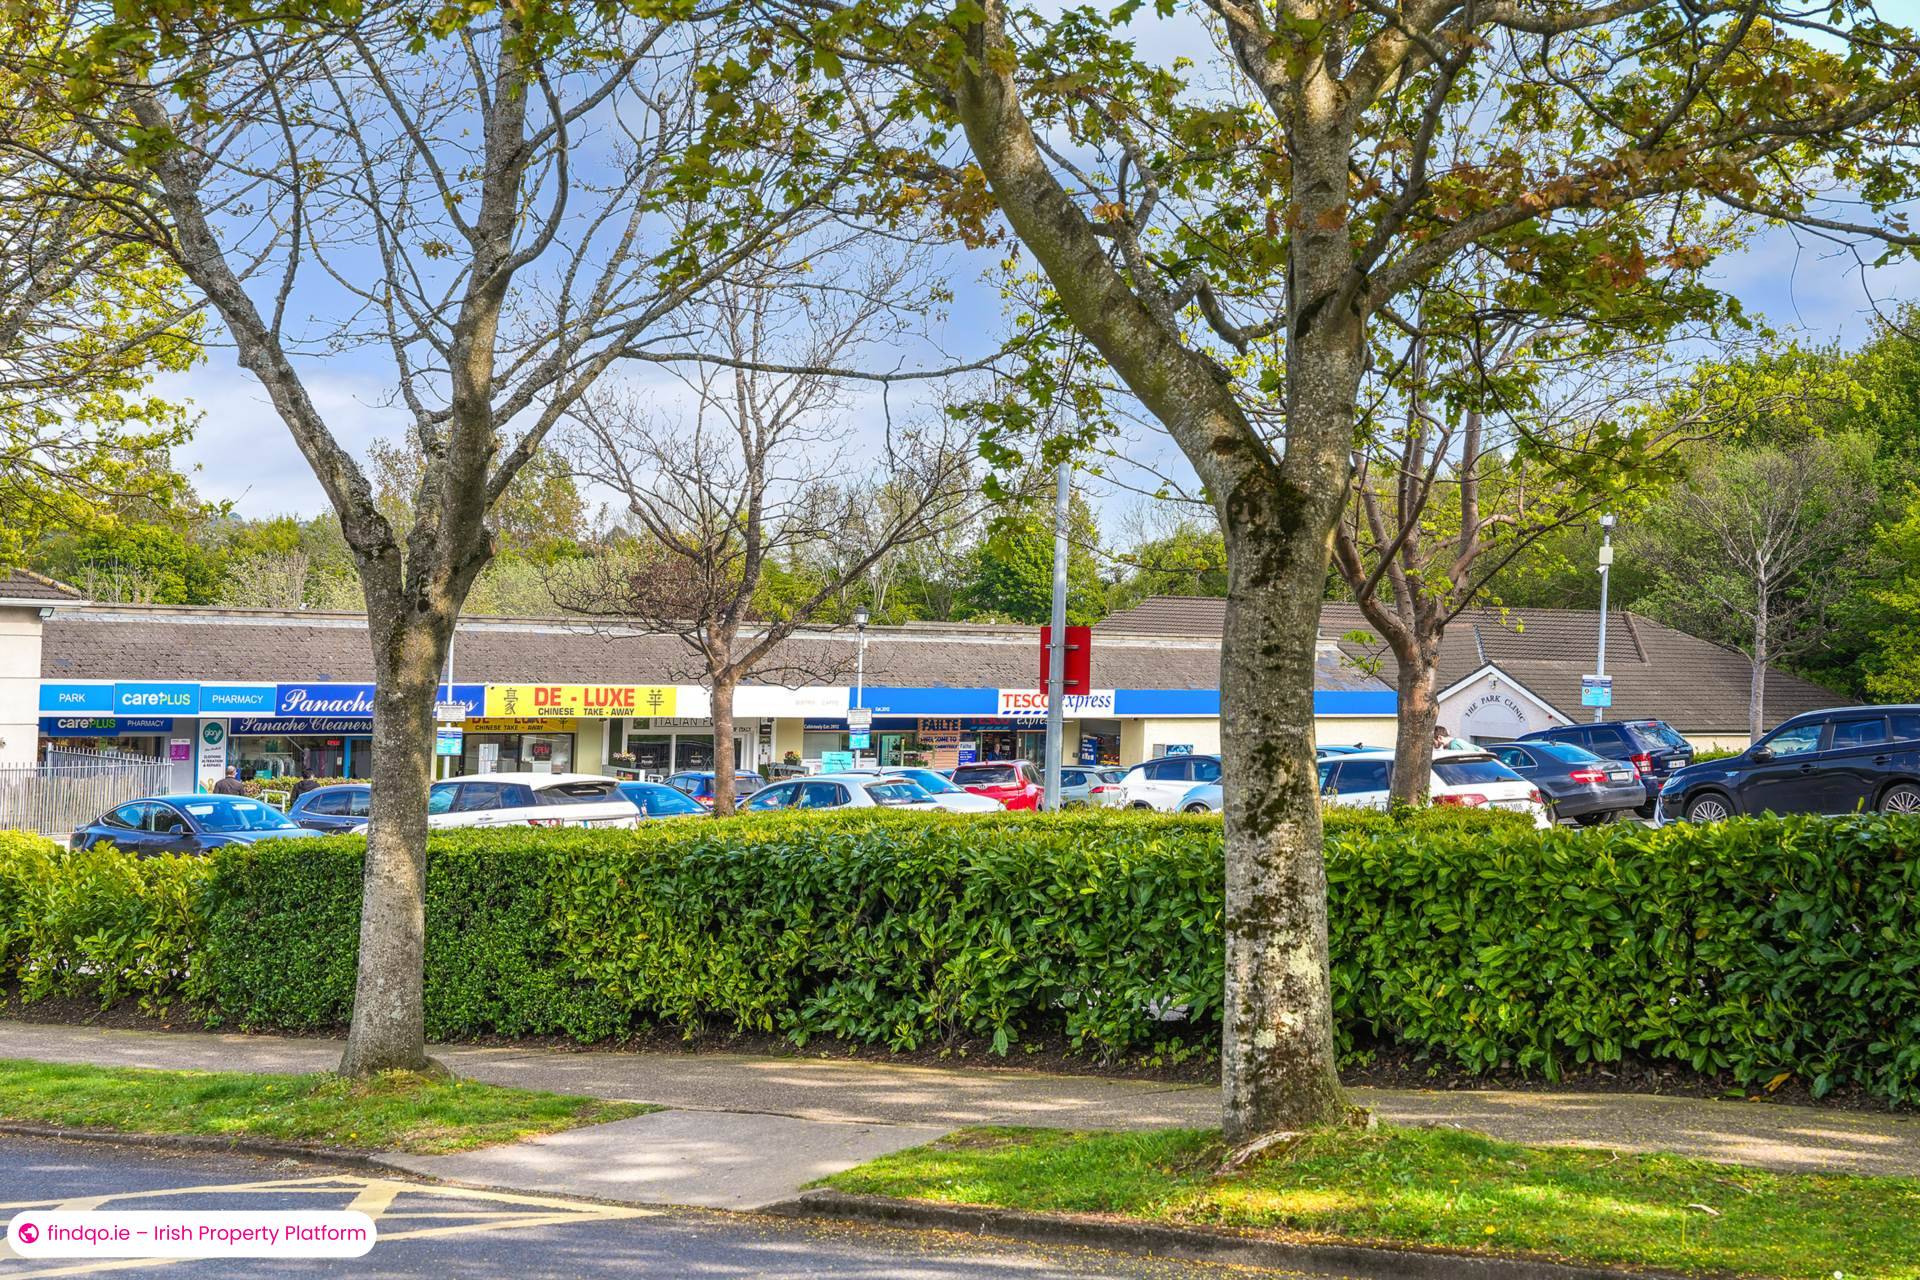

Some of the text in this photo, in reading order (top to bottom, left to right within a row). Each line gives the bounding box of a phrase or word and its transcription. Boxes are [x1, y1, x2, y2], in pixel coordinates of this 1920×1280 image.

[59, 693, 85, 703] PARK
[212, 695, 264, 704] PHARMACY
[281, 688, 374, 713] Panache
[534, 687, 561, 707] DE
[584, 687, 635, 707] LUXE
[538, 707, 574, 716] CHINESE
[584, 707, 604, 716] TAKE
[611, 707, 635, 716] AWAY
[1465, 694, 1526, 723] THE PARK CLINIC
[240, 717, 373, 732] Panache Cleaners
